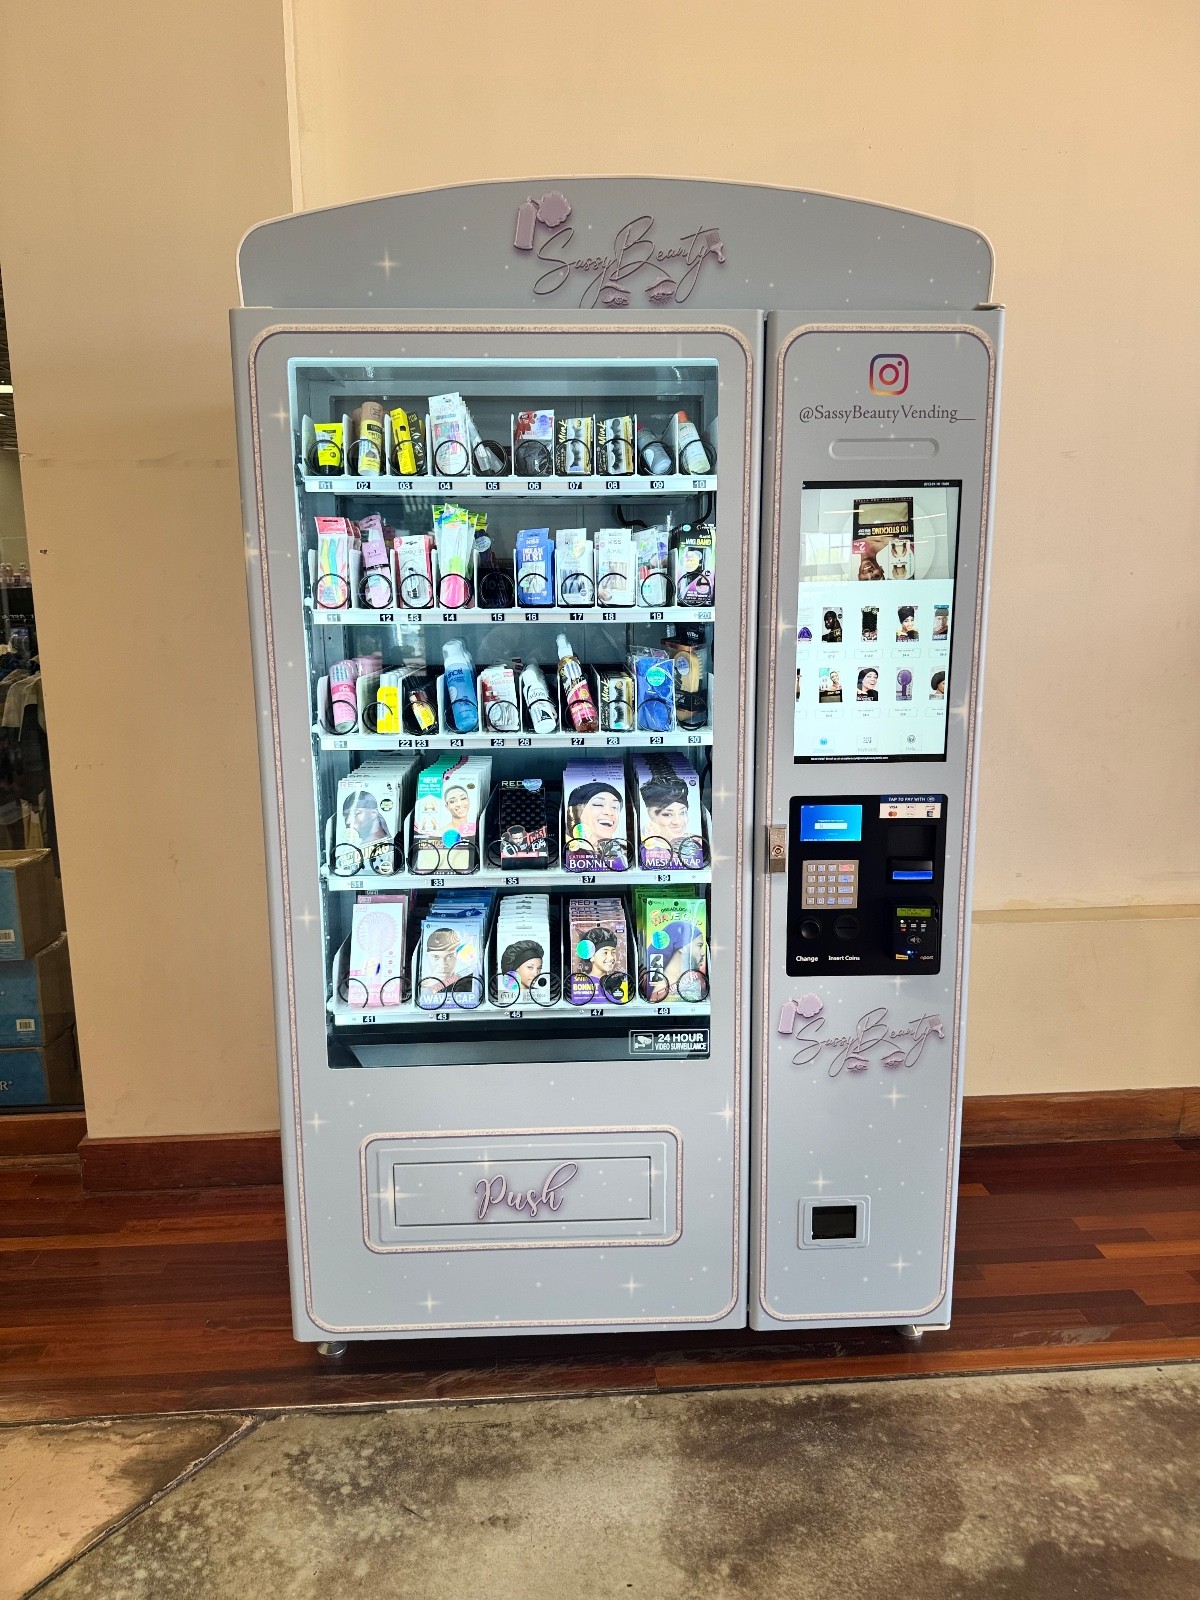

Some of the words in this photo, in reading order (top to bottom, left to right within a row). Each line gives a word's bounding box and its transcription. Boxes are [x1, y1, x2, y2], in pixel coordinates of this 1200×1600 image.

[609, 215, 720, 304] Beauty
[558, 419, 568, 444] Mink
[597, 420, 606, 445] Mink
[358, 481, 370, 490] 02
[399, 481, 410, 490] 03
[439, 481, 451, 490] 04
[487, 481, 498, 490] 05
[569, 859, 614, 868] BONNET
[645, 858, 670, 867] MESH
[671, 858, 700, 867] WRAP
[423, 994, 451, 1003] WAVE
[456, 994, 475, 1002] CAP
[658, 1034, 670, 1042] 24
[673, 1033, 703, 1042] HOUR
[852, 1007, 940, 1068] Beauty
[475, 1161, 578, 1220] Push
